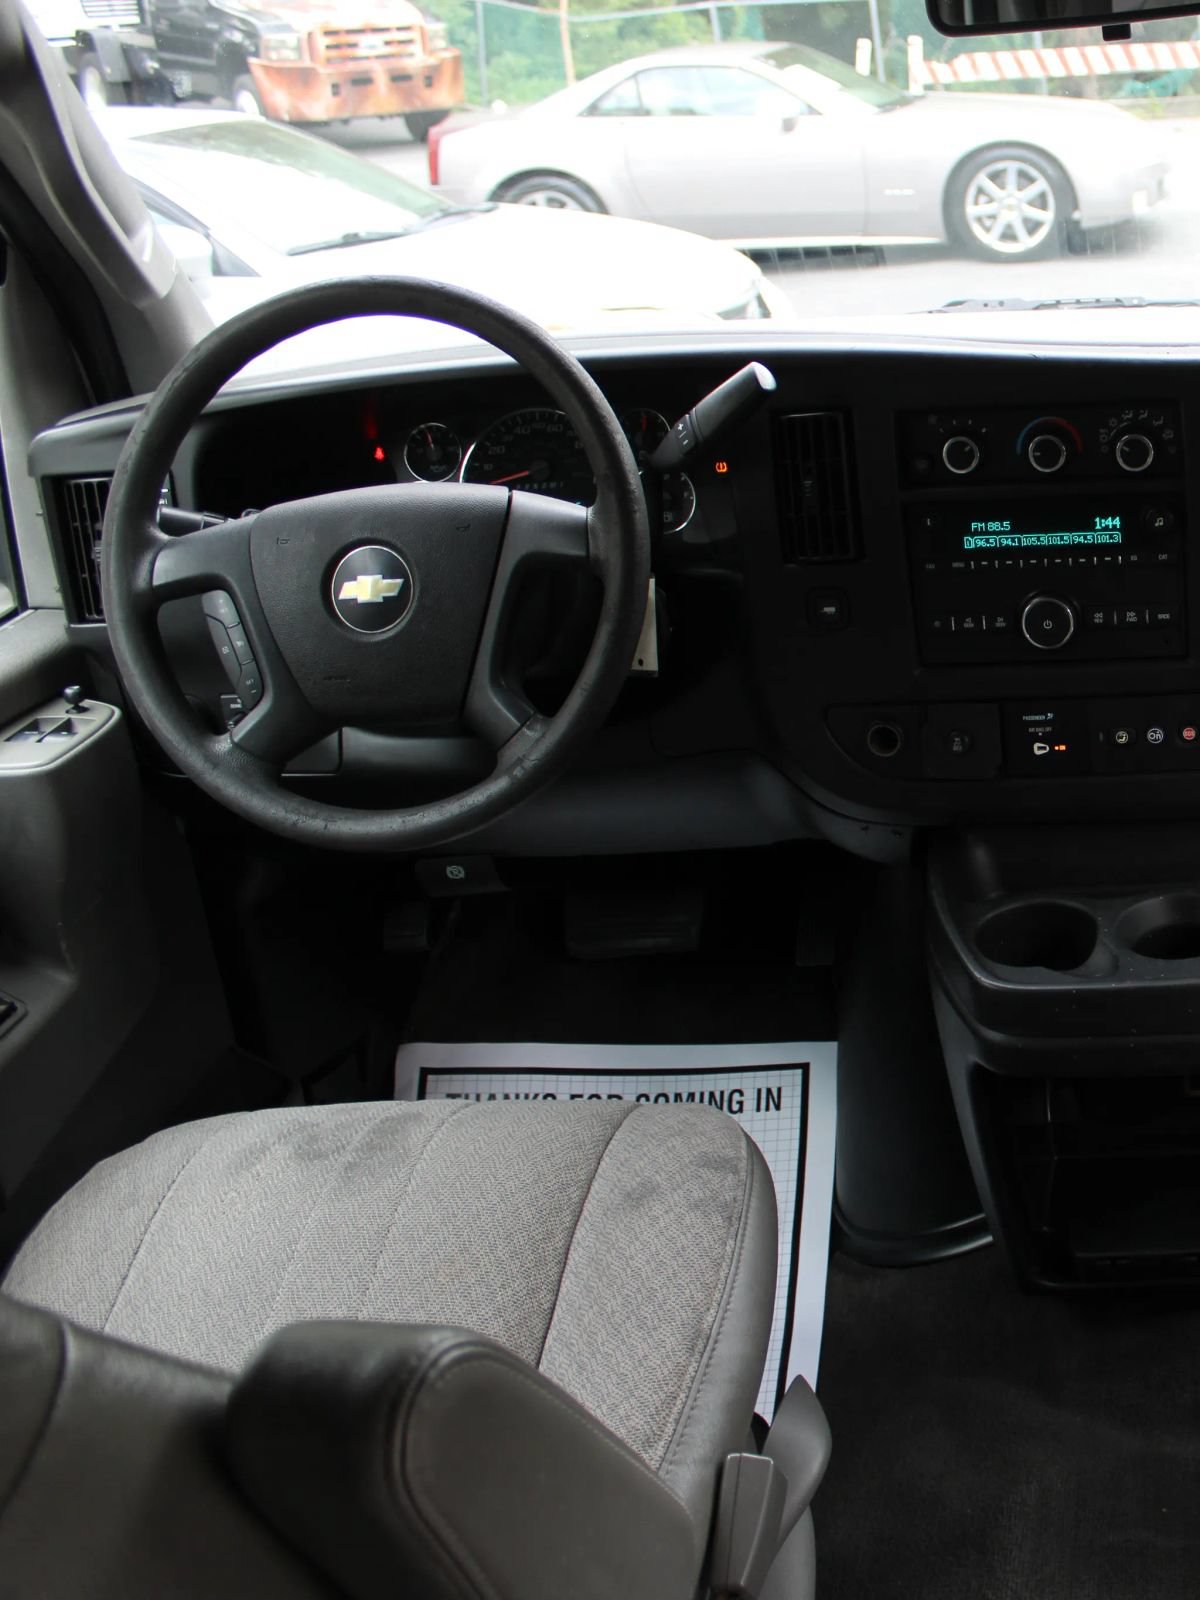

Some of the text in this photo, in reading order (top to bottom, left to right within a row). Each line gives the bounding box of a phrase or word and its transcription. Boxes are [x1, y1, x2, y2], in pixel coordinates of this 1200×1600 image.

[971, 521, 1011, 532] FM 88.5
[1094, 516, 1121, 529] 1:44
[975, 534, 1119, 547] 96.5 94.1 105.5 101.5 94.5 101.3
[755, 1086, 783, 1112] IN
